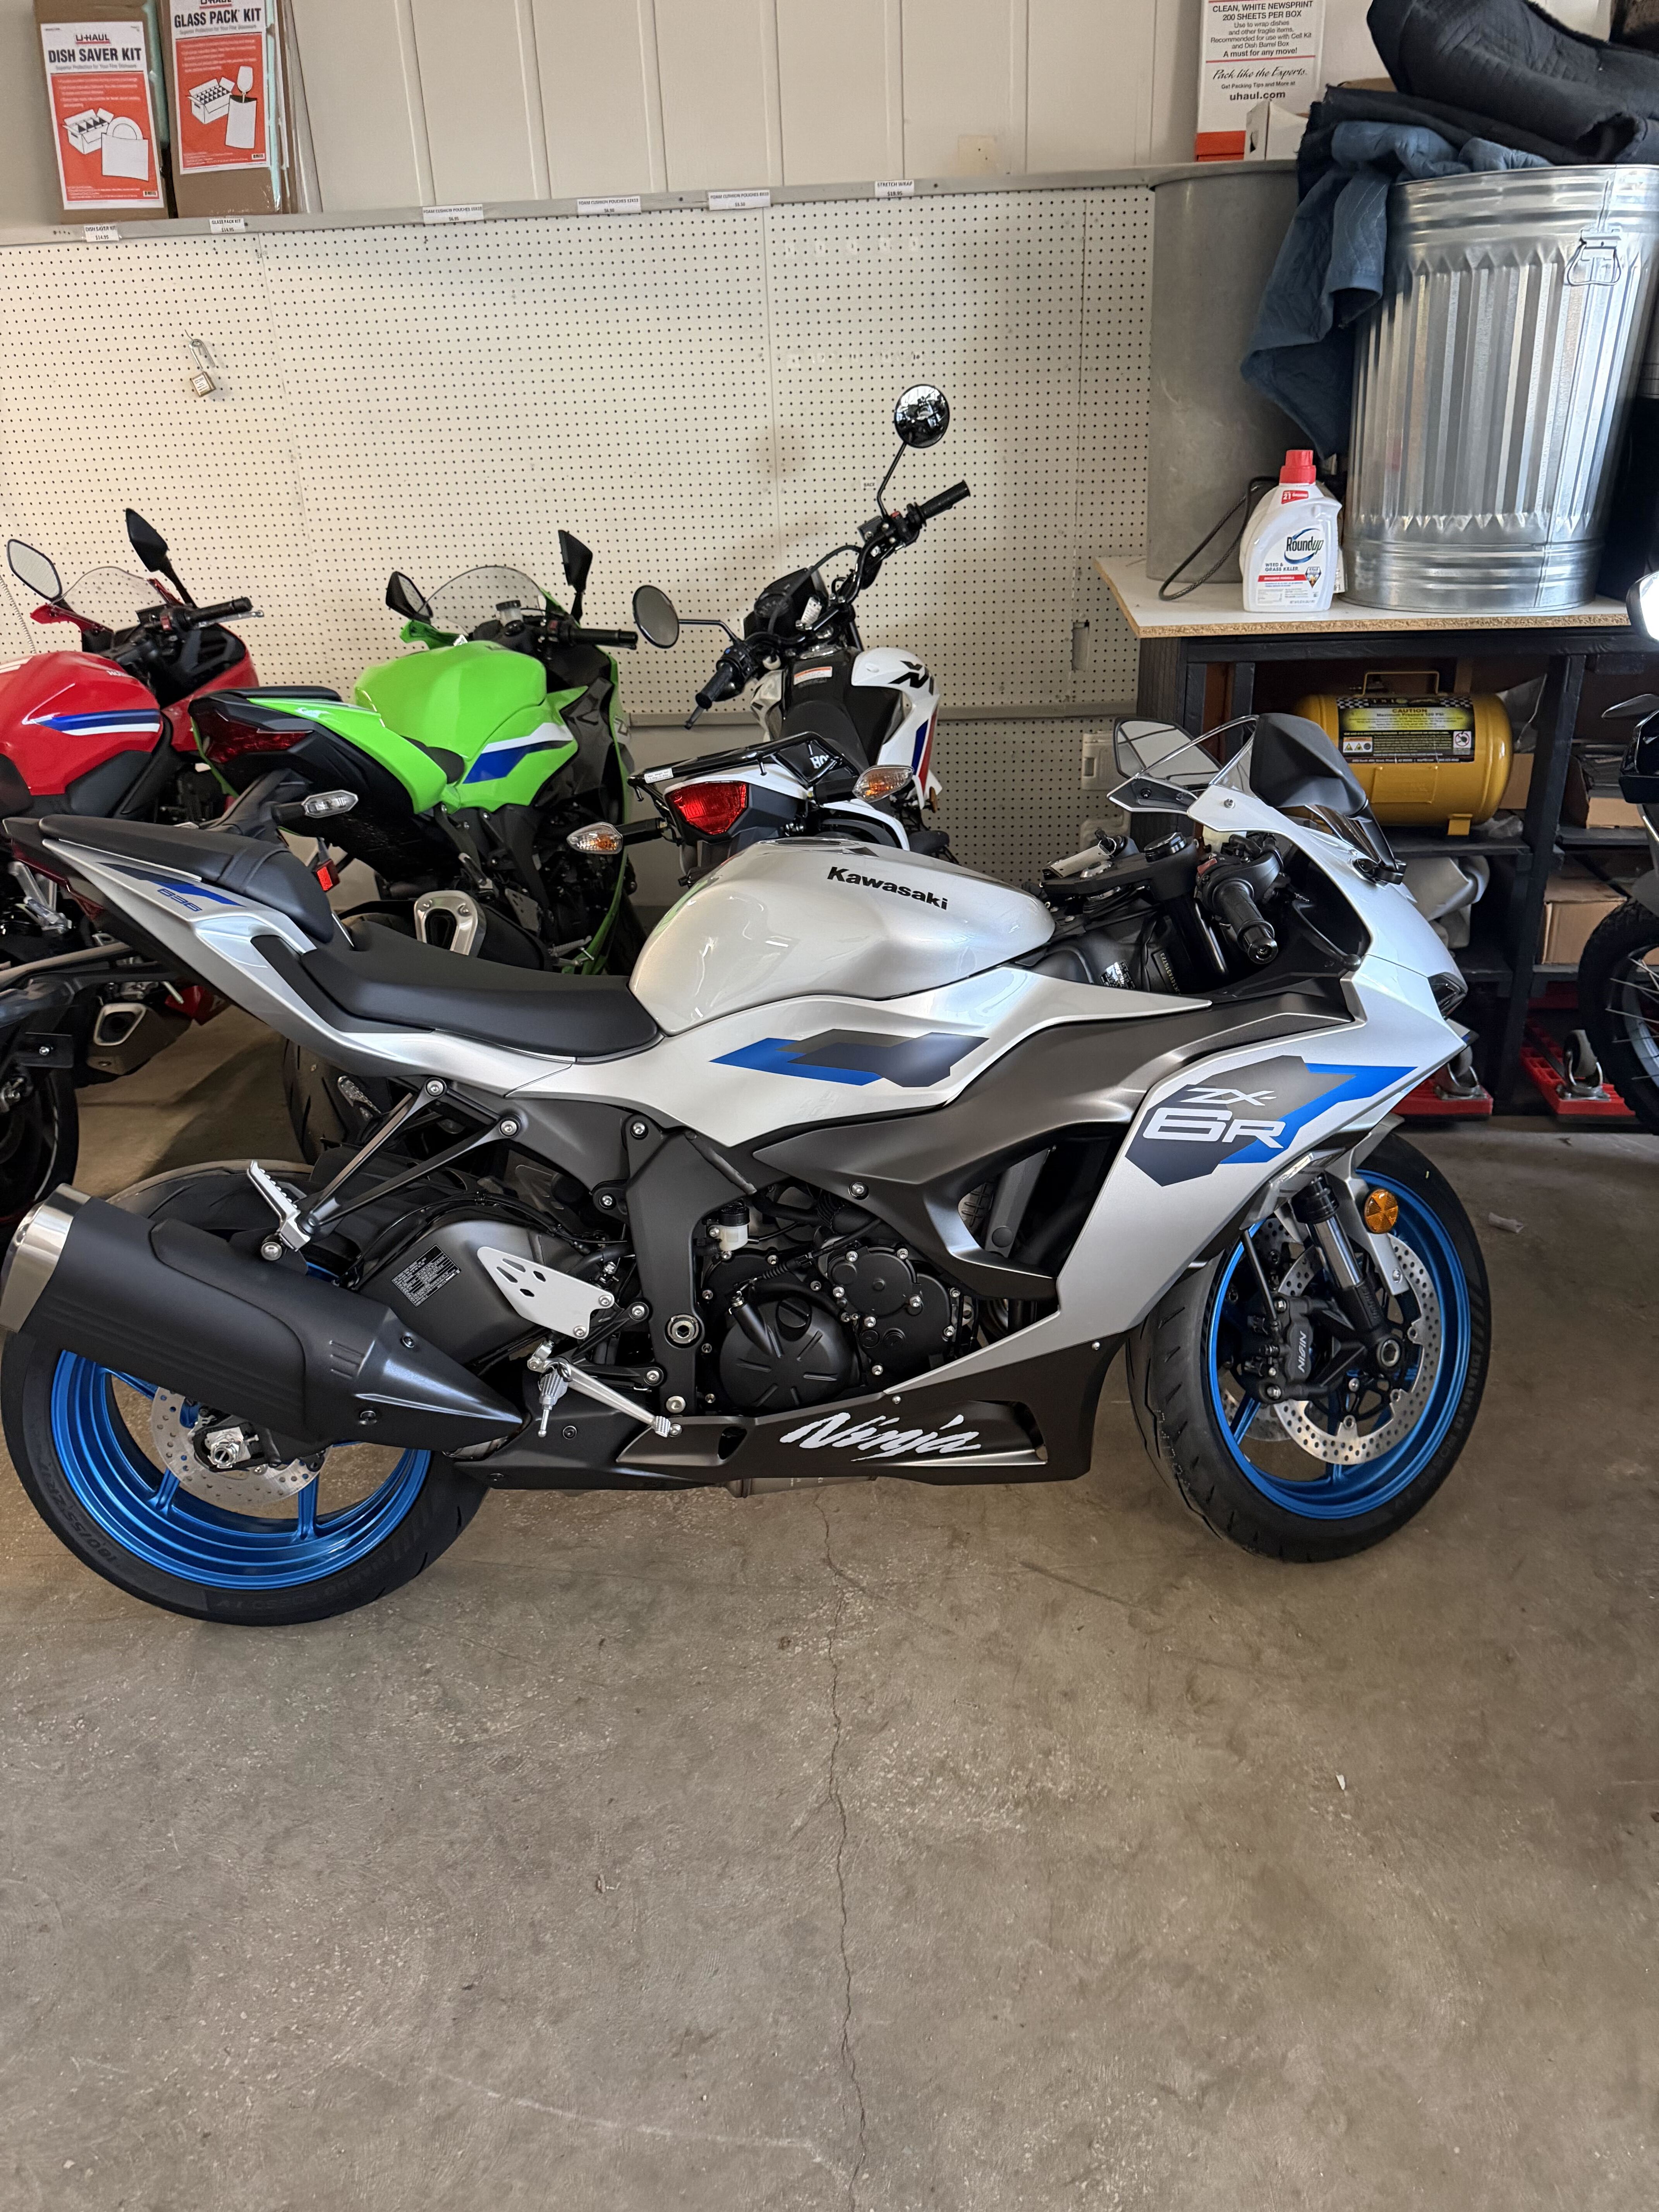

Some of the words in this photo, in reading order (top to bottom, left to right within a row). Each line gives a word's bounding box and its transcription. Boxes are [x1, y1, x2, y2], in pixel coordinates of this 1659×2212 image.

[1268, 1, 1313, 10] NEWSPRINT
[175, 12, 206, 28] GLASS
[210, 9, 238, 24] PACK
[244, 8, 261, 22] KIT
[1211, 35, 1255, 43] Recommended
[48, 49, 76, 63] DISH
[79, 48, 118, 62] SAVER
[121, 47, 141, 61] KIT
[1213, 69, 1235, 80] Pack
[1237, 69, 1254, 78] like
[1255, 68, 1270, 77] the
[1230, 91, 1285, 101] uhaul.com
[1286, 536, 1324, 555] Roundup
[827, 866, 948, 910] Kawasaki
[157, 888, 203, 912] 636
[1143, 1108, 1286, 1149] 6R
[1298, 1330, 1307, 1373] NISSIN
[779, 1412, 981, 1462] Ninja
